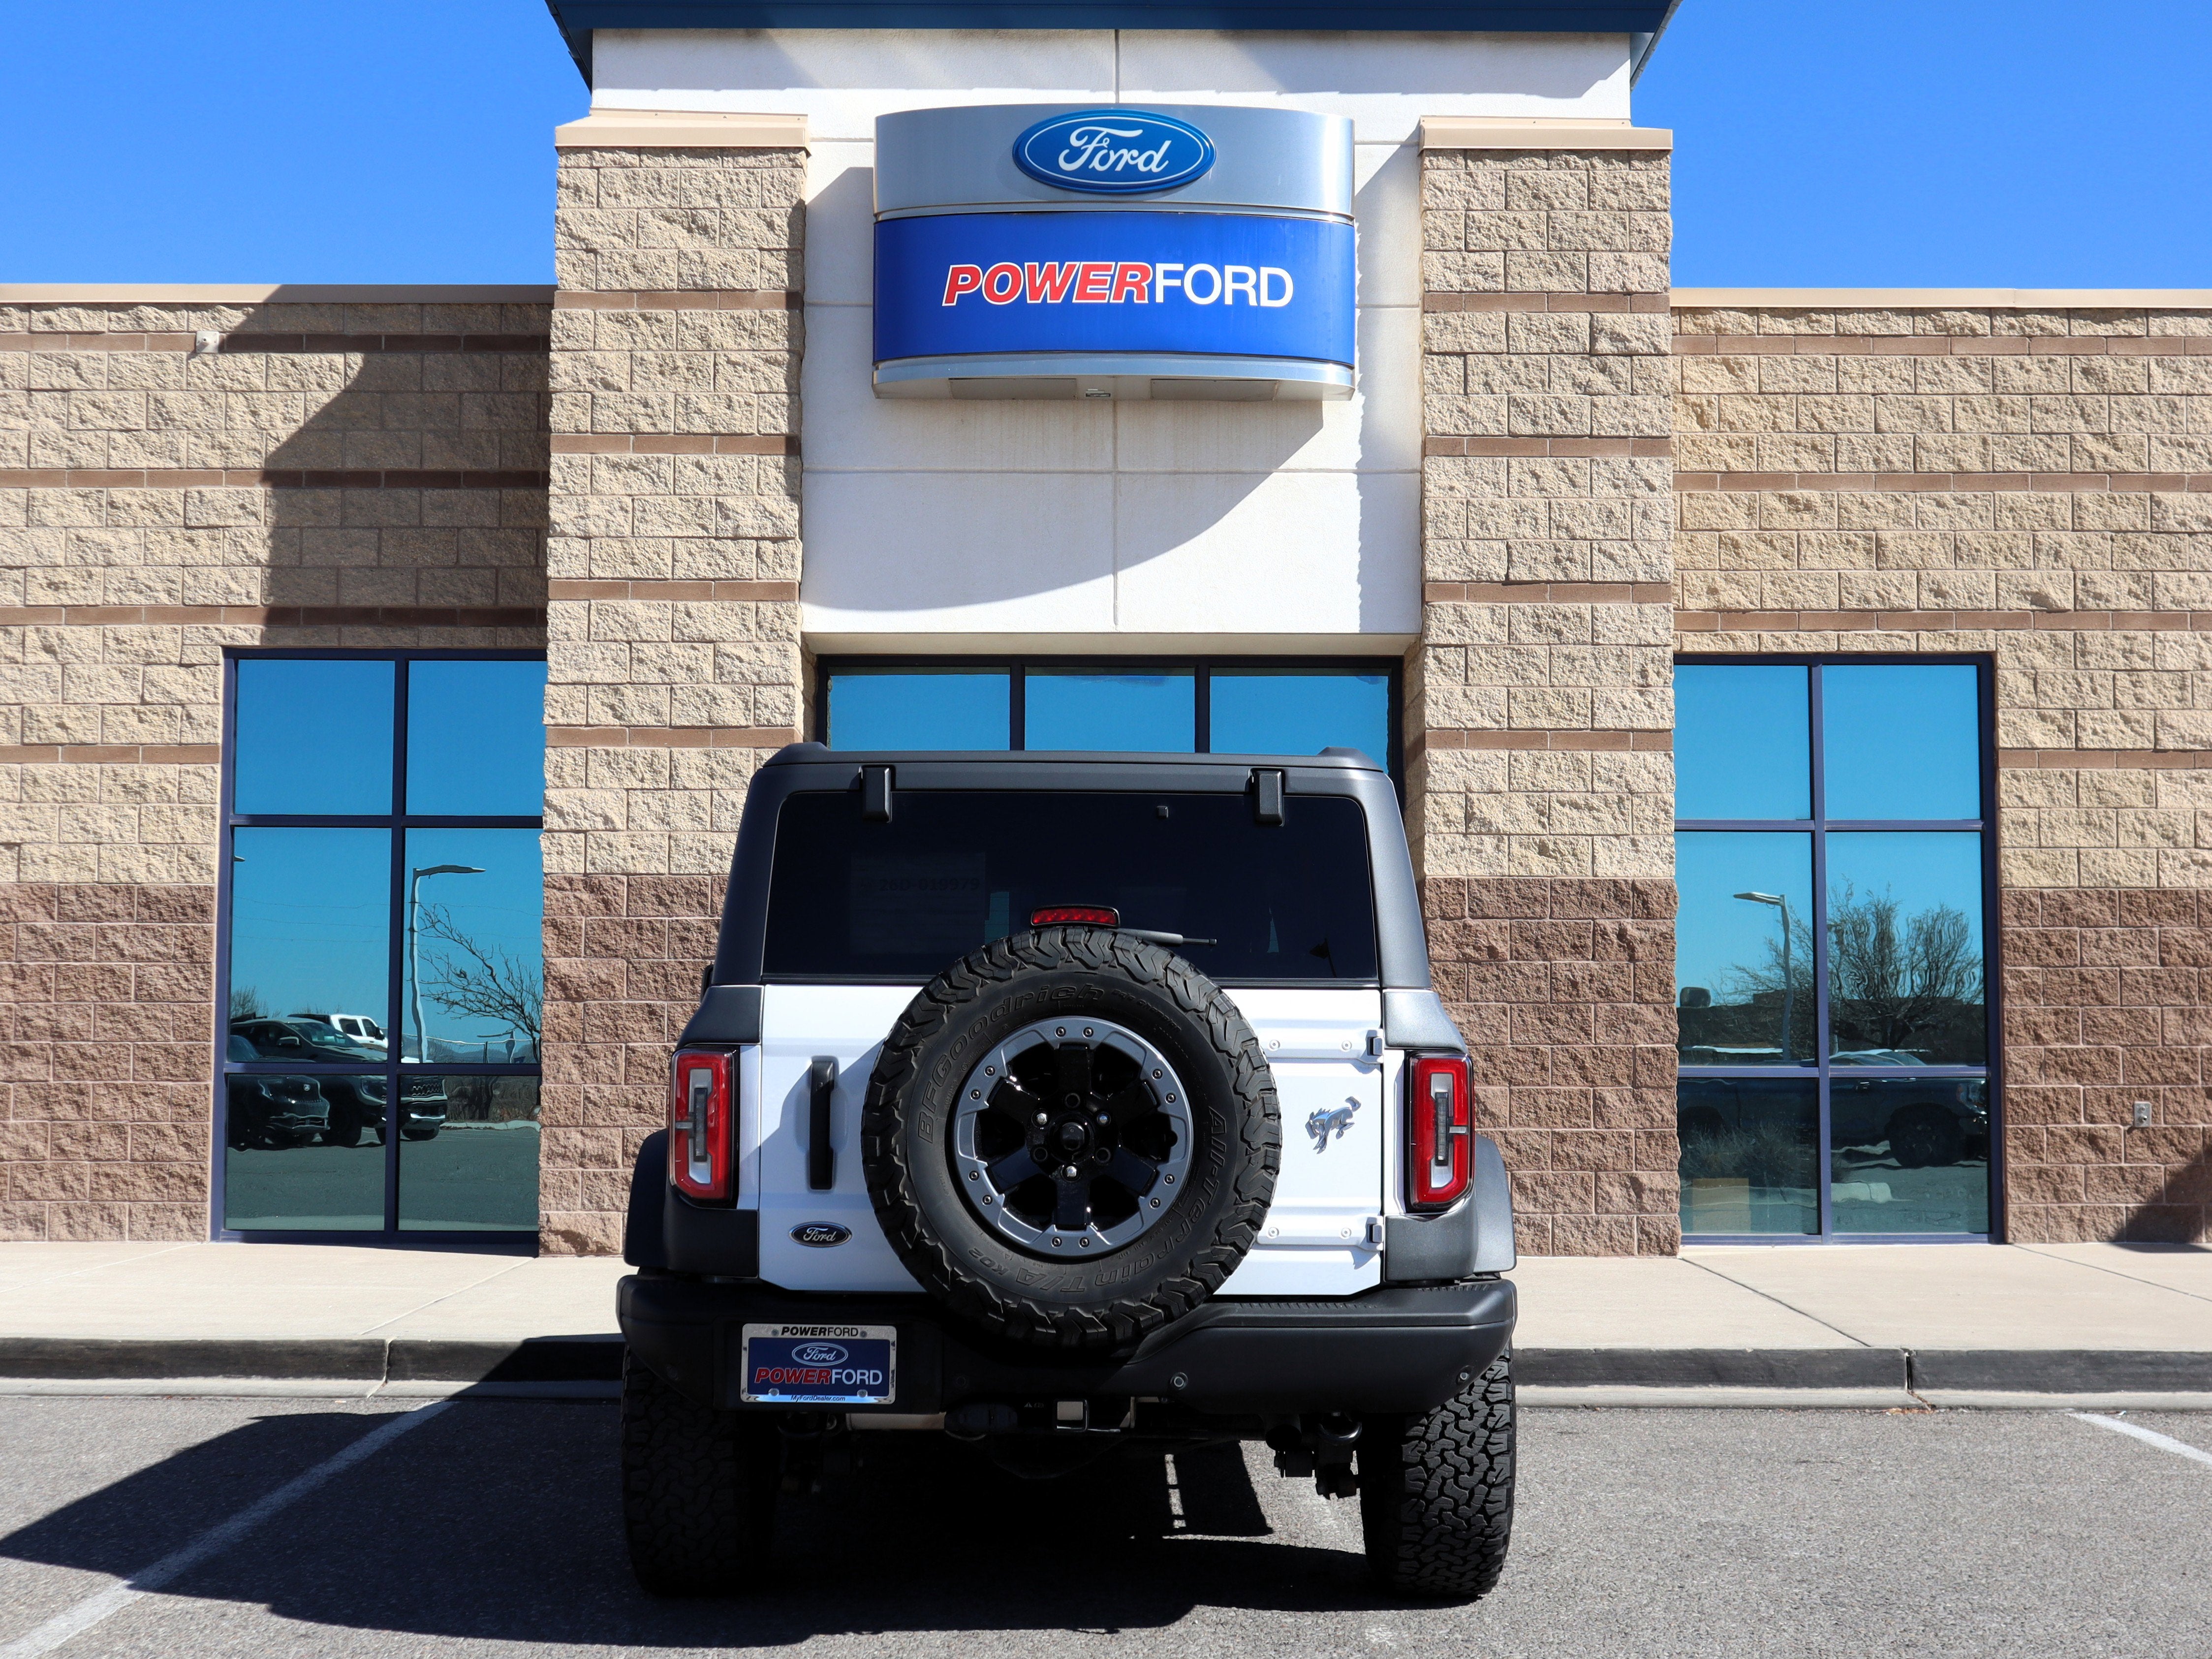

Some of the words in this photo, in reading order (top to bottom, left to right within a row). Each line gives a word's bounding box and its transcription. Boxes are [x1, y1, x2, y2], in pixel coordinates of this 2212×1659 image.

[1058, 126, 1171, 172] Ford
[942, 261, 1294, 308] POWERFORD
[917, 982, 1105, 1144] BFGoodrich
[1094, 1105, 1227, 1287] All-Terrain
[803, 1227, 837, 1242] Ford
[1015, 1268, 1085, 1293] T/A
[781, 1326, 859, 1337] POWERFORD
[803, 1346, 836, 1361] Ford
[754, 1367, 883, 1385] POWERFORD
[790, 1394, 846, 1403] MyFordDealer.com
